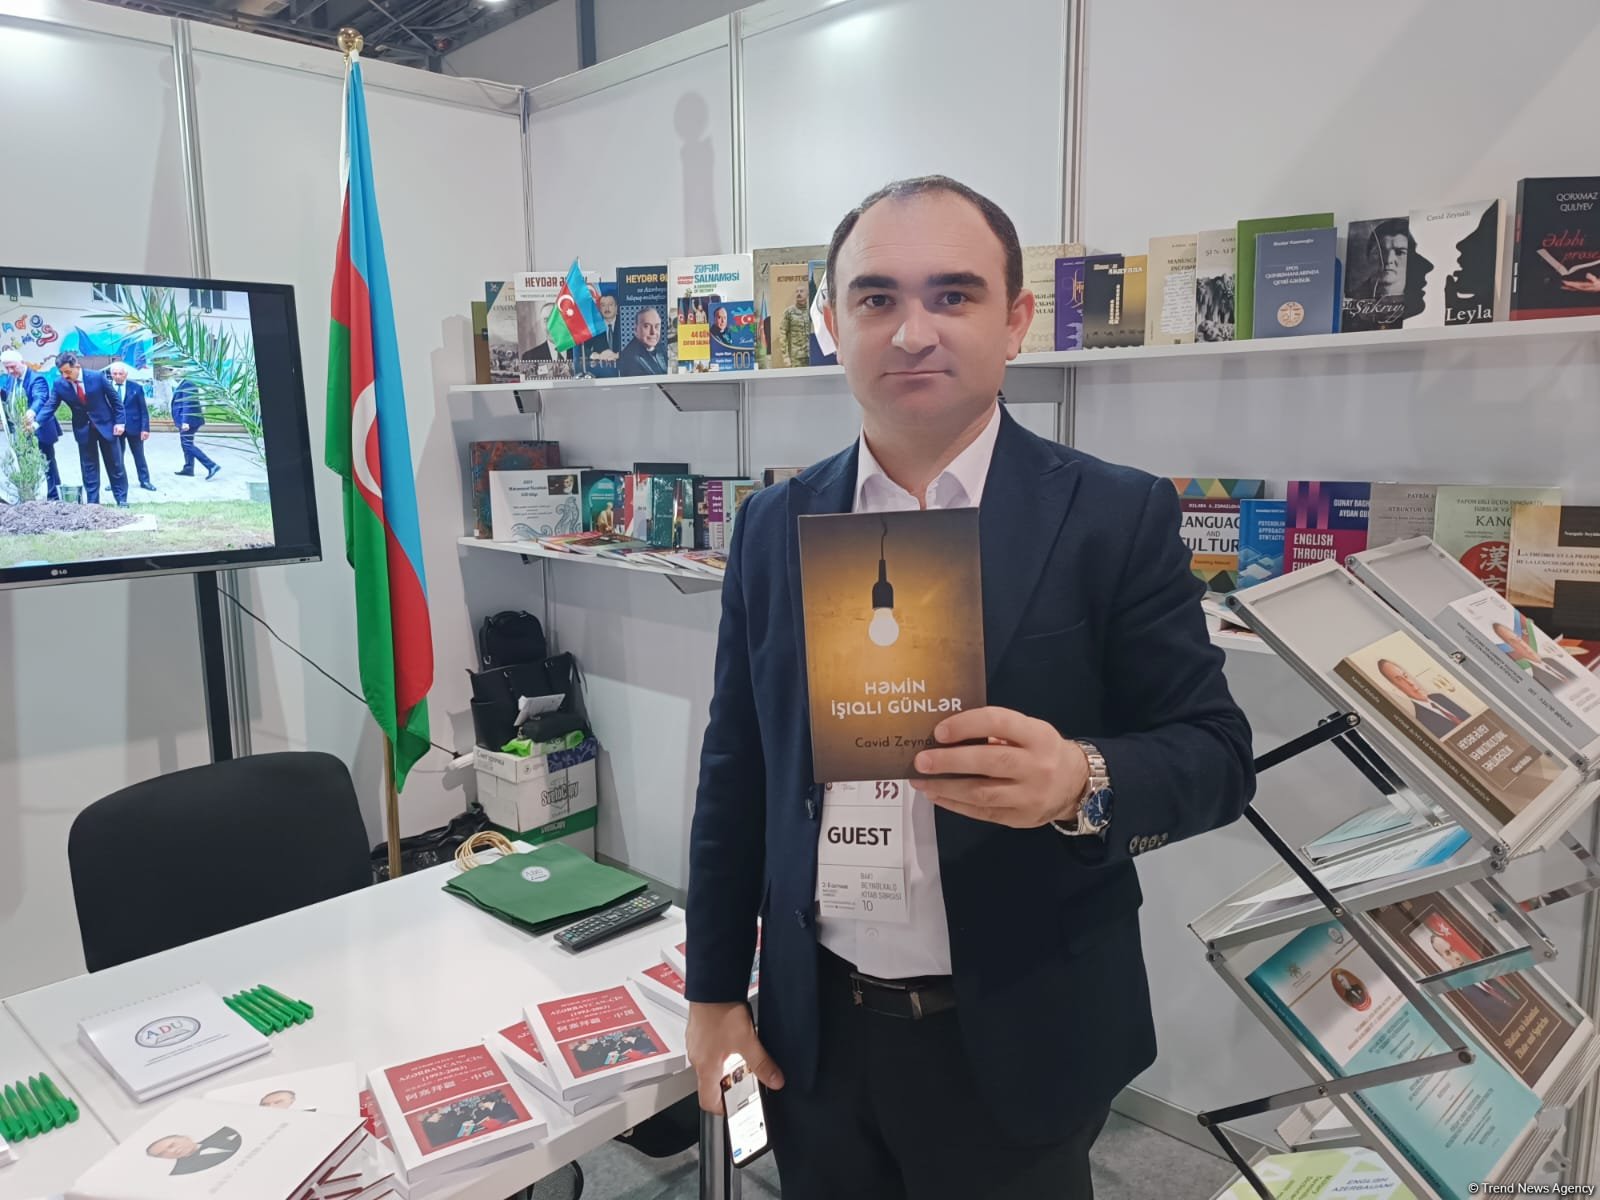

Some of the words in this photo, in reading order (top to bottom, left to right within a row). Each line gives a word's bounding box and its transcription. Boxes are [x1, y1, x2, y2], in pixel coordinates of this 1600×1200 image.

[525, 277, 558, 288] HEYDƏR
[625, 273, 658, 285] HEYDƏR
[1446, 305, 1492, 324] Leyla
[1180, 515, 1240, 529] ANGUAG
[1206, 530, 1221, 538] AND
[1293, 533, 1334, 547] ENGLISH
[1182, 537, 1240, 553] ULTUR
[1292, 547, 1337, 561] THROUGH
[864, 677, 926, 695] HƏMİN
[831, 700, 881, 720] İŞIQLI
[887, 696, 963, 714] GÜNLƏR
[855, 736, 890, 748] Cavid
[895, 736, 937, 749] Zeynal
[827, 826, 892, 846] GUEST
[862, 900, 874, 912] 10
